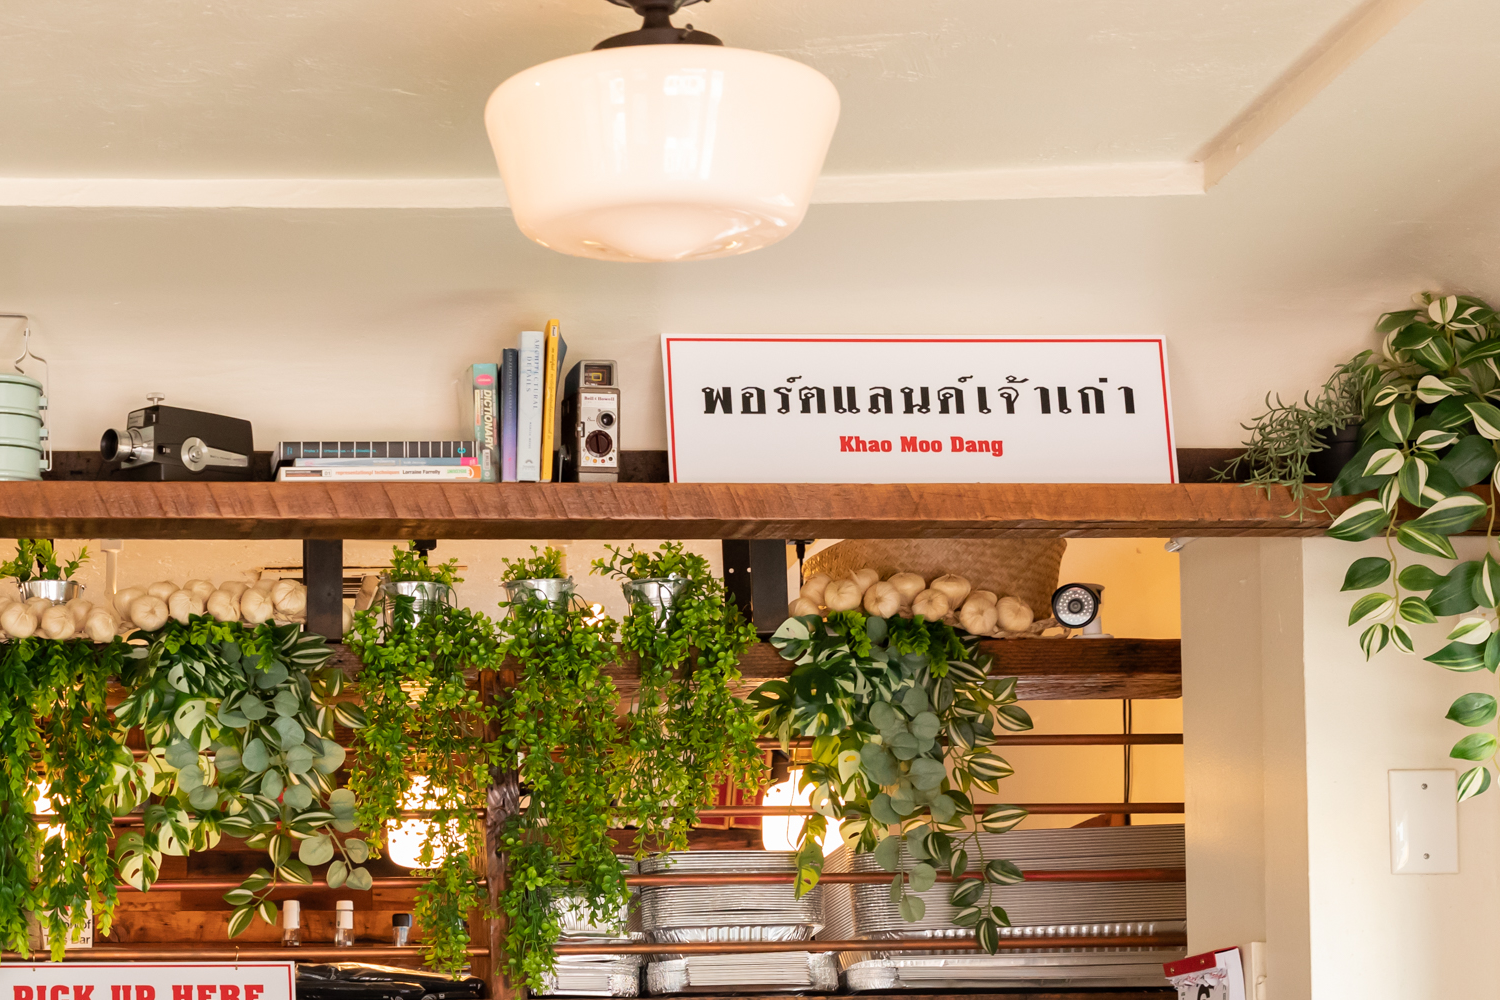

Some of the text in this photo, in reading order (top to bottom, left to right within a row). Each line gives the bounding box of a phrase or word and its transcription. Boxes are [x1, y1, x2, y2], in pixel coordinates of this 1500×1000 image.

[701, 375, 1136, 414] พอร์ตแลนด์เจ้าเก่า
[483, 389, 493, 450] DICTIONARY
[840, 436, 1004, 457] Khao Moo Dang
